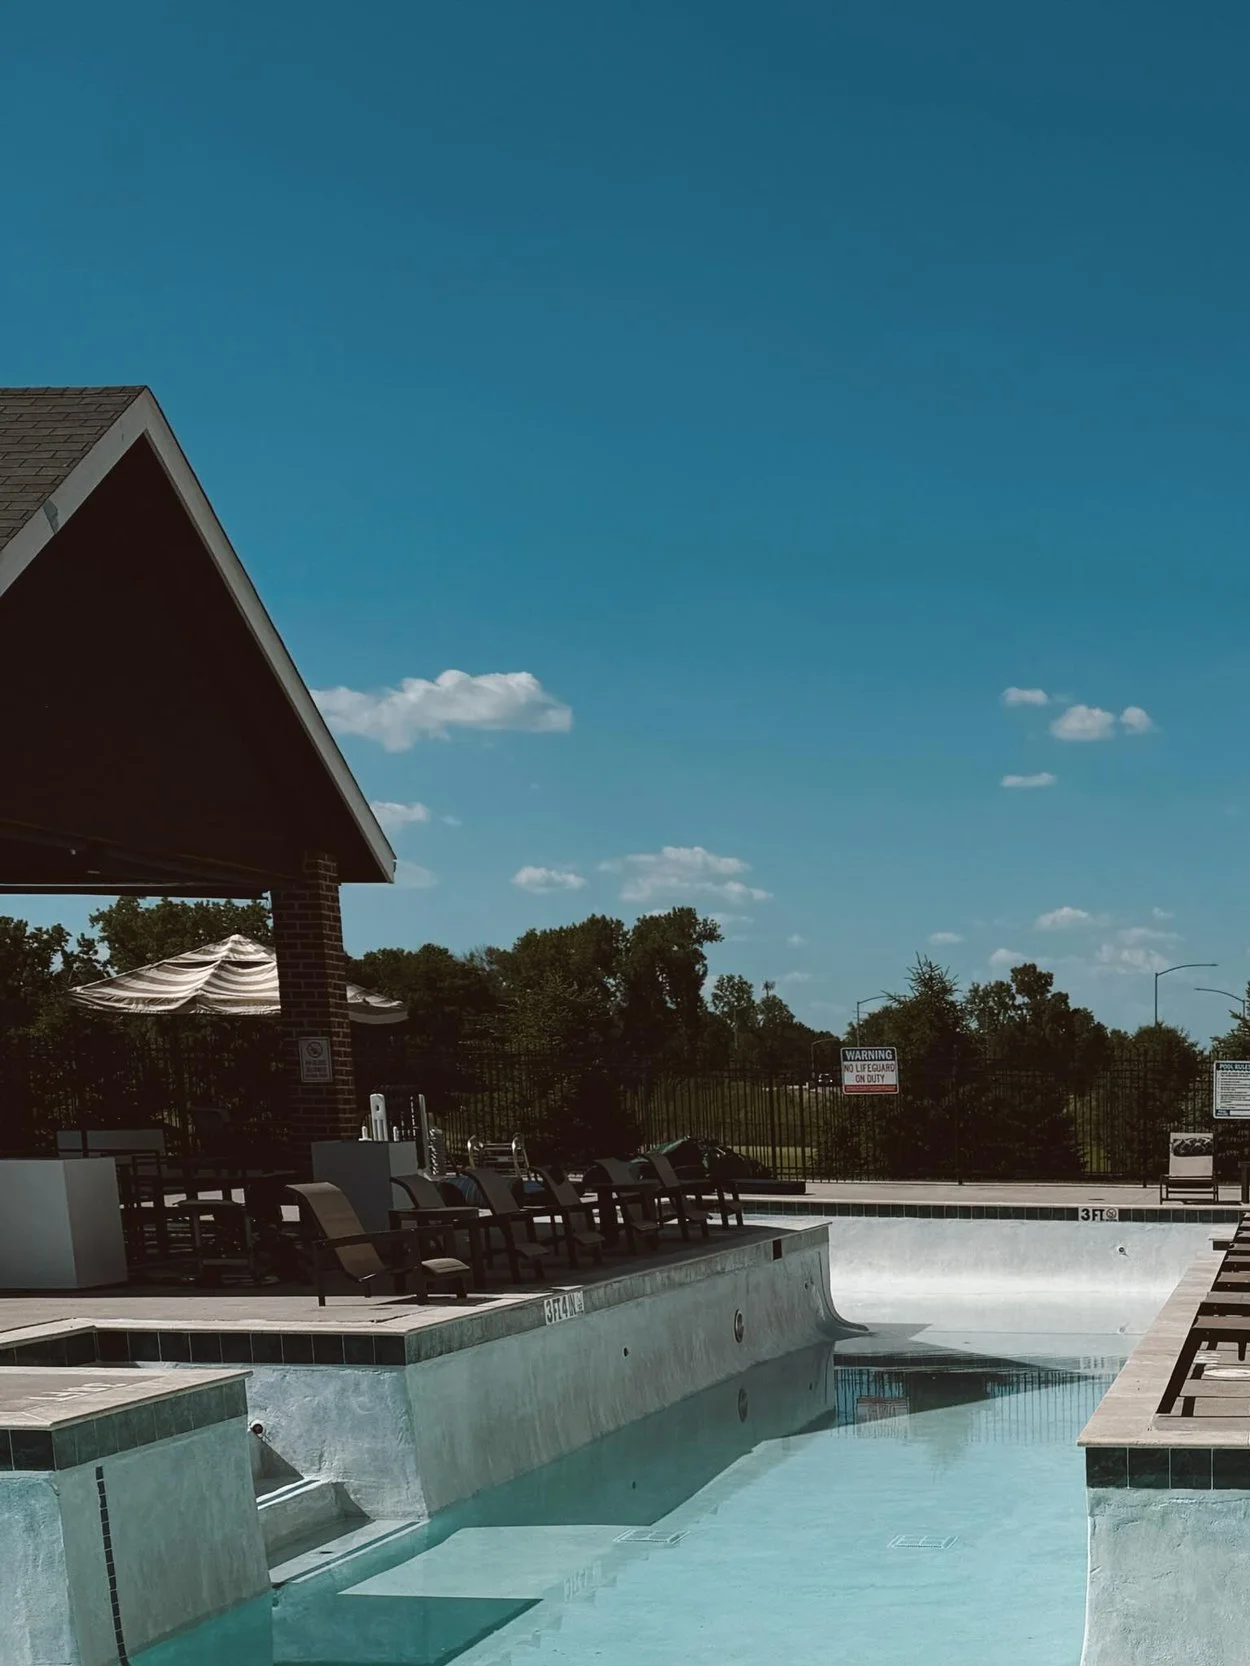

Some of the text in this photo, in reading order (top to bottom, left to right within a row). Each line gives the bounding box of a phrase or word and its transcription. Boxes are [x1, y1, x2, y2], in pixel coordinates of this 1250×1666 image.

[845, 1050, 893, 1060] WARNING
[844, 1063, 896, 1073] NO LIFEGUARD
[855, 1074, 885, 1083] ON DUTY
